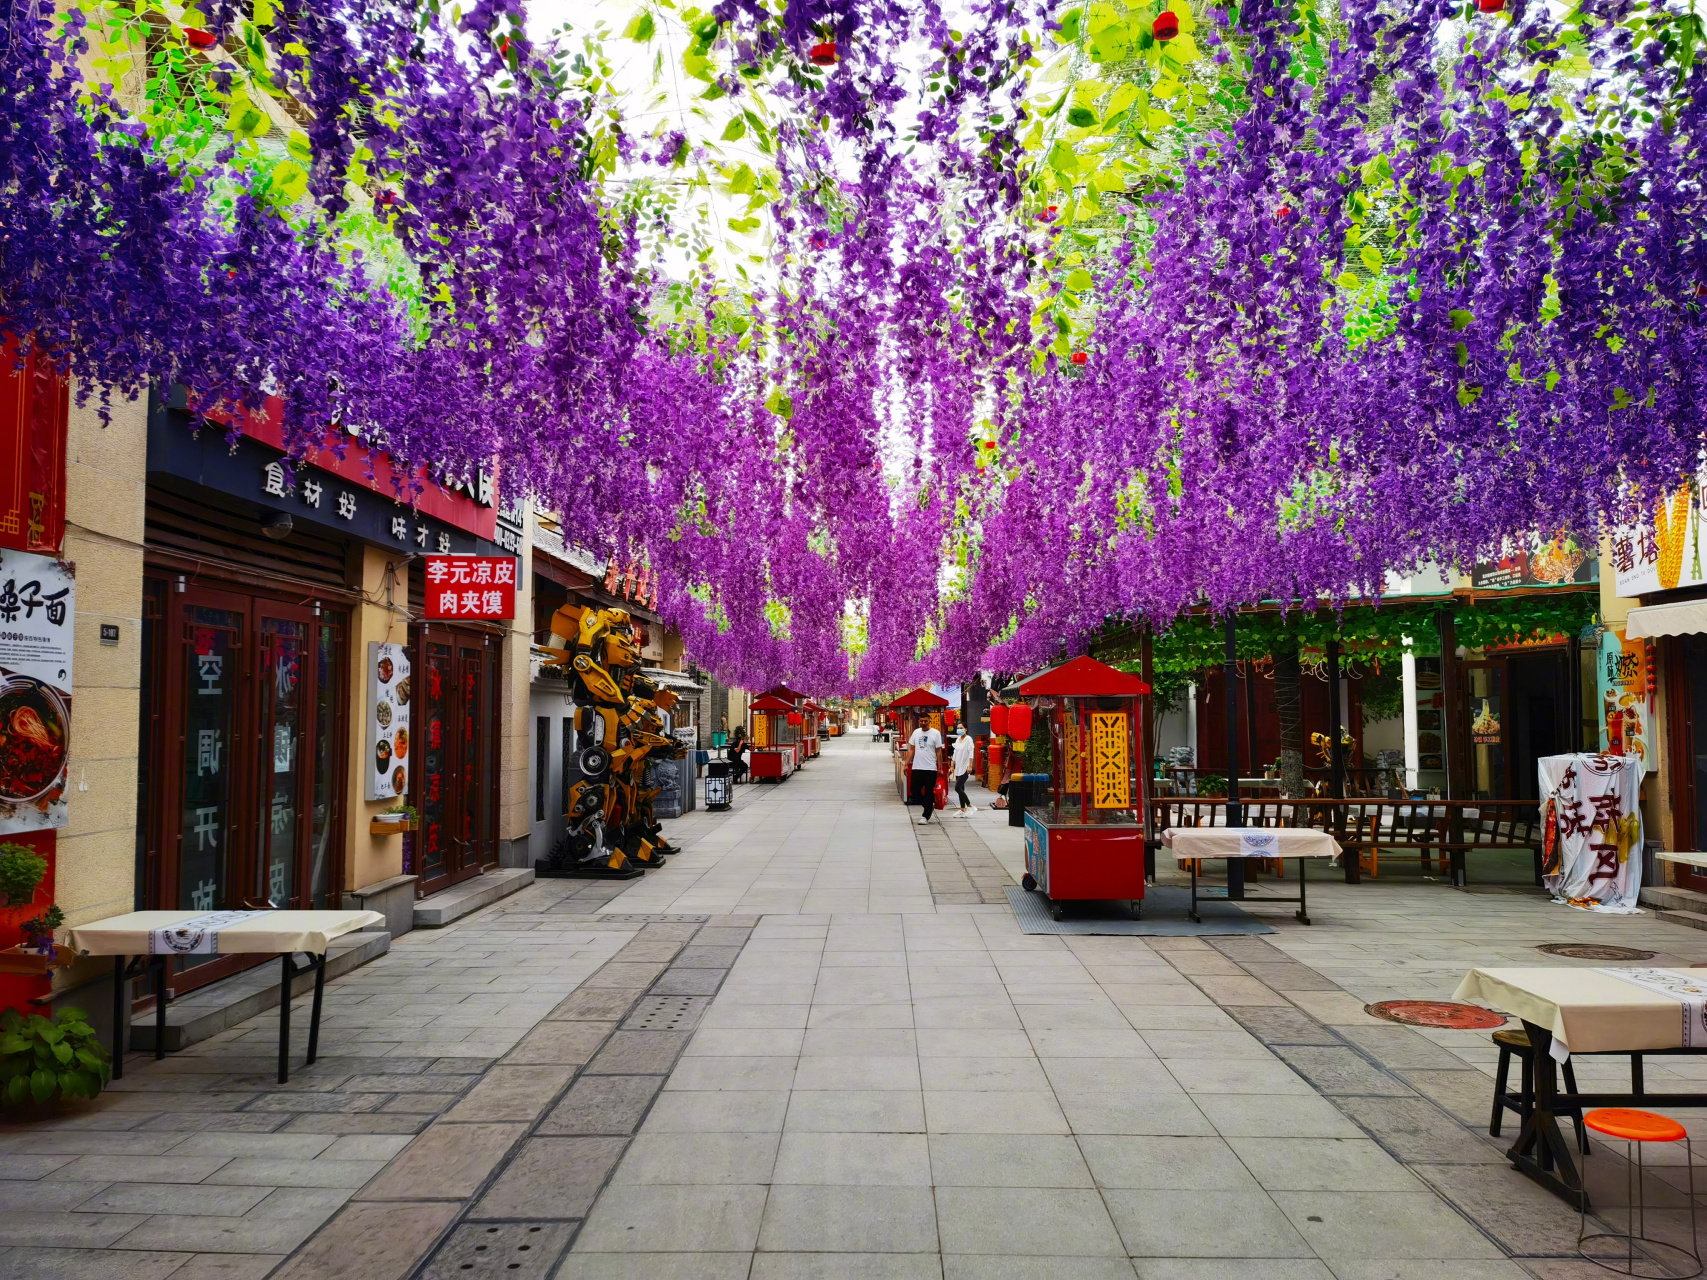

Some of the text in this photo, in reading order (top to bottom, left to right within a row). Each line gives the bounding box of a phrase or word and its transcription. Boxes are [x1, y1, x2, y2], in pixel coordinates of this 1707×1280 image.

[264, 461, 451, 555] 食材好 味才好
[427, 561, 514, 585] 李元凉皮
[438, 590, 503, 615] 肉夹馍
